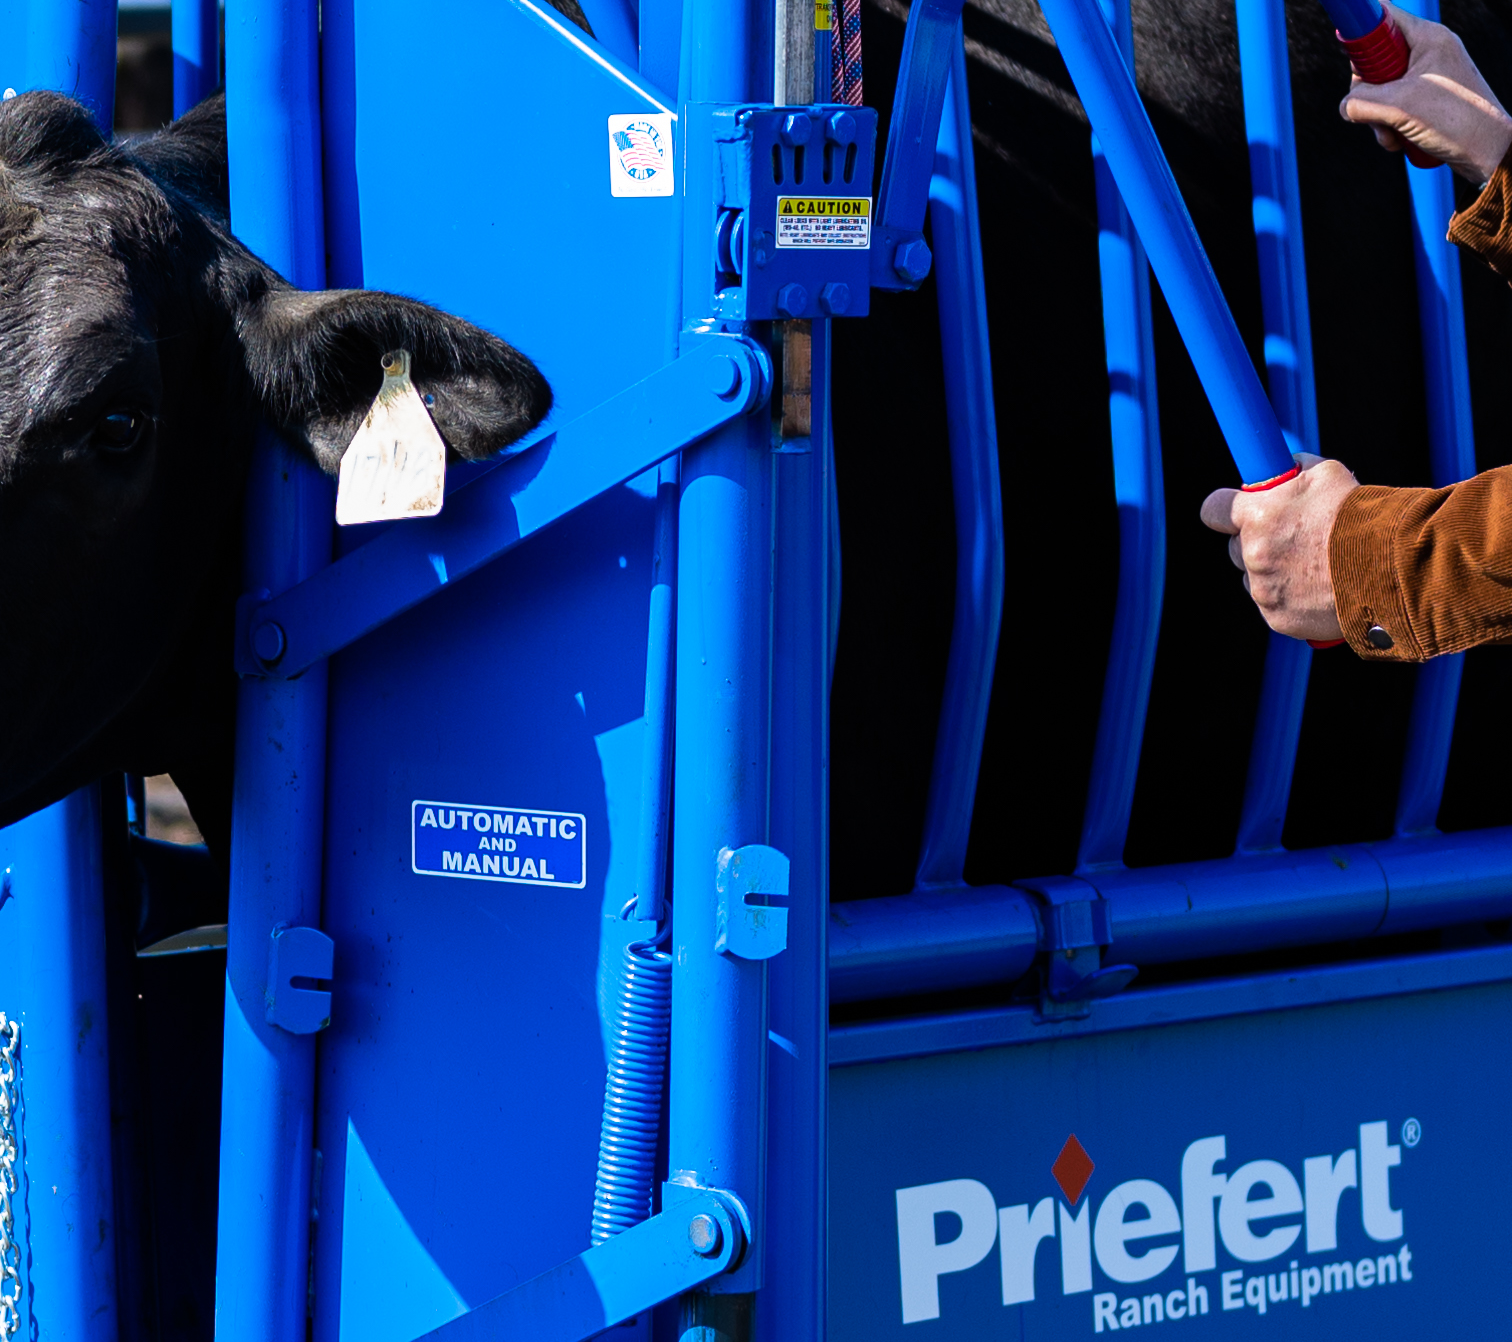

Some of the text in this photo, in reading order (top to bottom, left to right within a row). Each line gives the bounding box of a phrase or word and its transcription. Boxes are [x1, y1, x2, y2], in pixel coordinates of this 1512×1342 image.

[796, 201, 861, 214] CAUTION
[419, 807, 577, 840] AUTOMATIC
[478, 836, 517, 853] AND
[441, 850, 555, 880] MANUAL
[1092, 1243, 1413, 1333] Ranch Equipment
